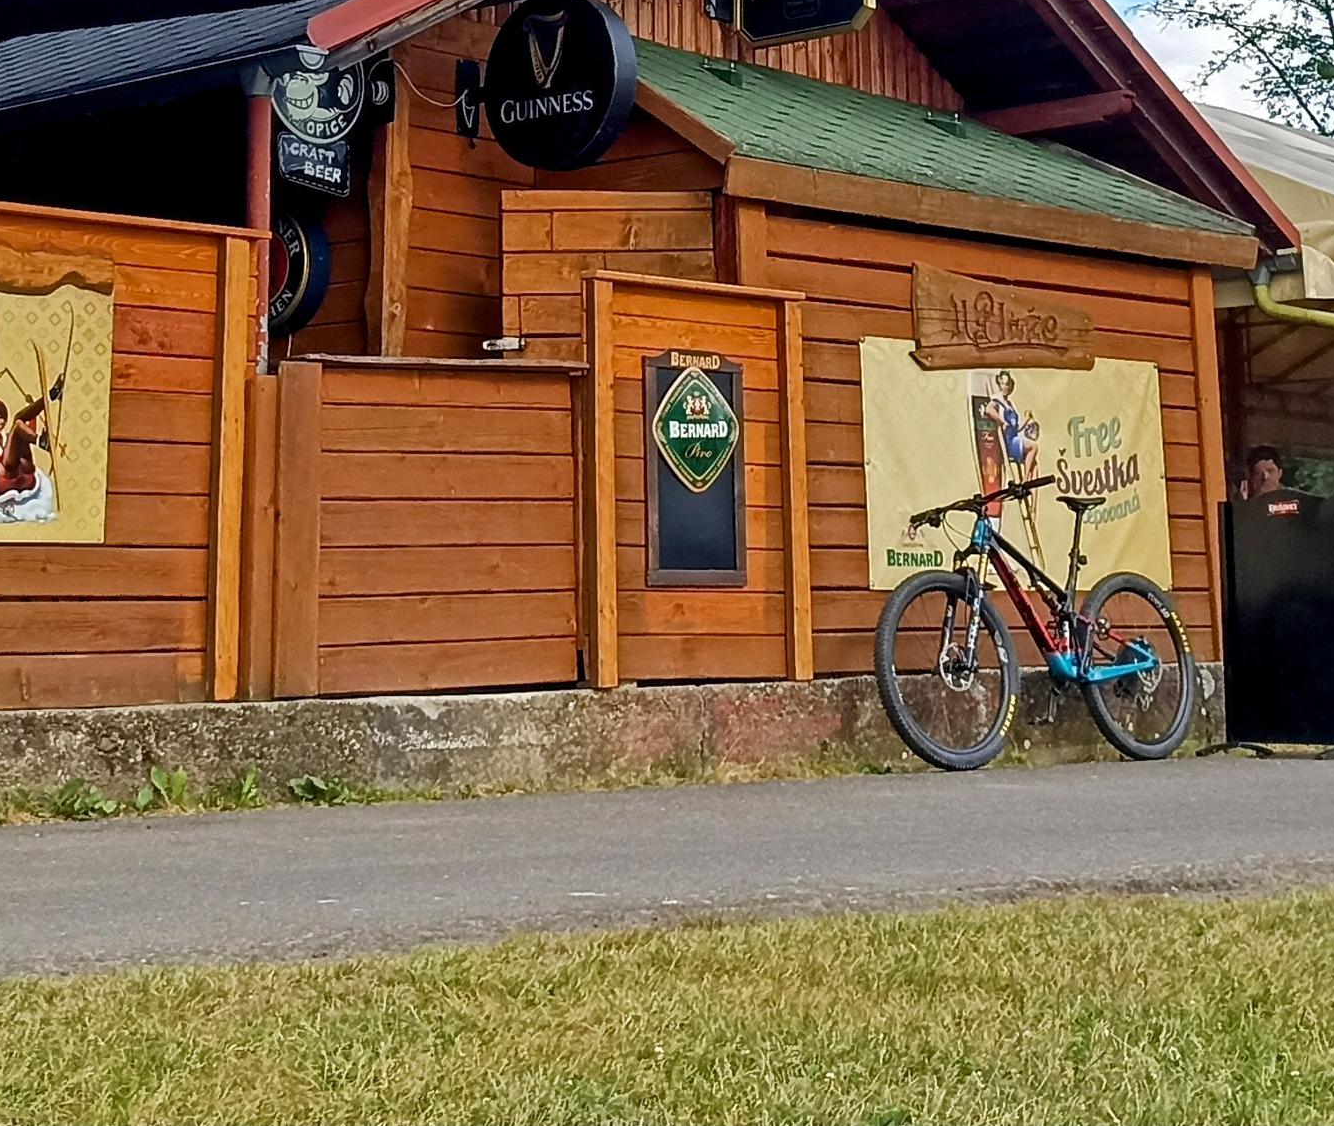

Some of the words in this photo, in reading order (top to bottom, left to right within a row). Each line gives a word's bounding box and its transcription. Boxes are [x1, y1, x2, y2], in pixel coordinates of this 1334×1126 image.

[501, 90, 594, 124] GUINNESS
[307, 114, 347, 136] OPICE
[290, 142, 335, 164] CRAFT
[304, 161, 341, 183] BEER
[670, 352, 720, 370] BERNARD
[669, 421, 728, 438] BERNARD
[1067, 415, 1122, 458] Free
[1056, 447, 1140, 496] Švestka
[886, 549, 944, 567] BERNARD
